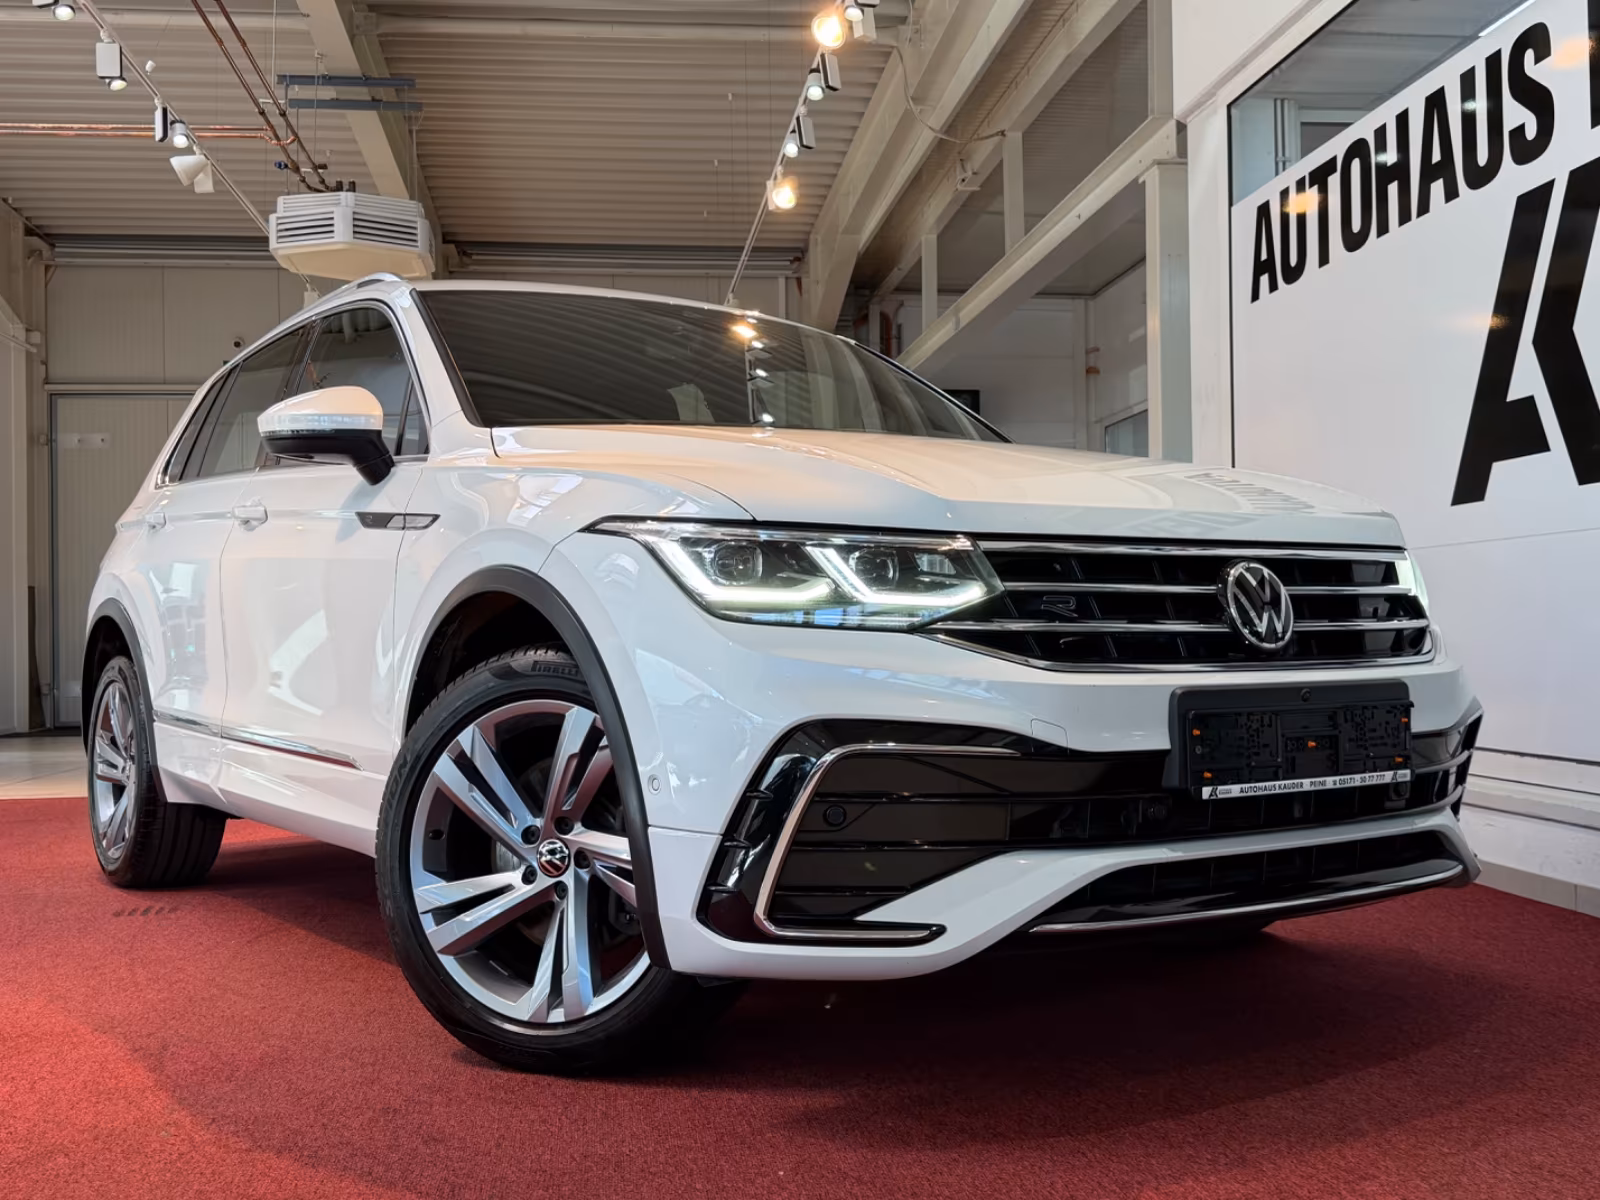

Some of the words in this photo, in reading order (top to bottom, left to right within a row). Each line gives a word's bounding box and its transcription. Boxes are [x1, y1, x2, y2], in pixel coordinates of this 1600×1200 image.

[1250, 21, 1555, 304] AUTOHAUS
[1239, 784, 1277, 794] AUTOHAUS
[1278, 781, 1304, 791] KAUDER
[1309, 779, 1327, 788] PEINE
